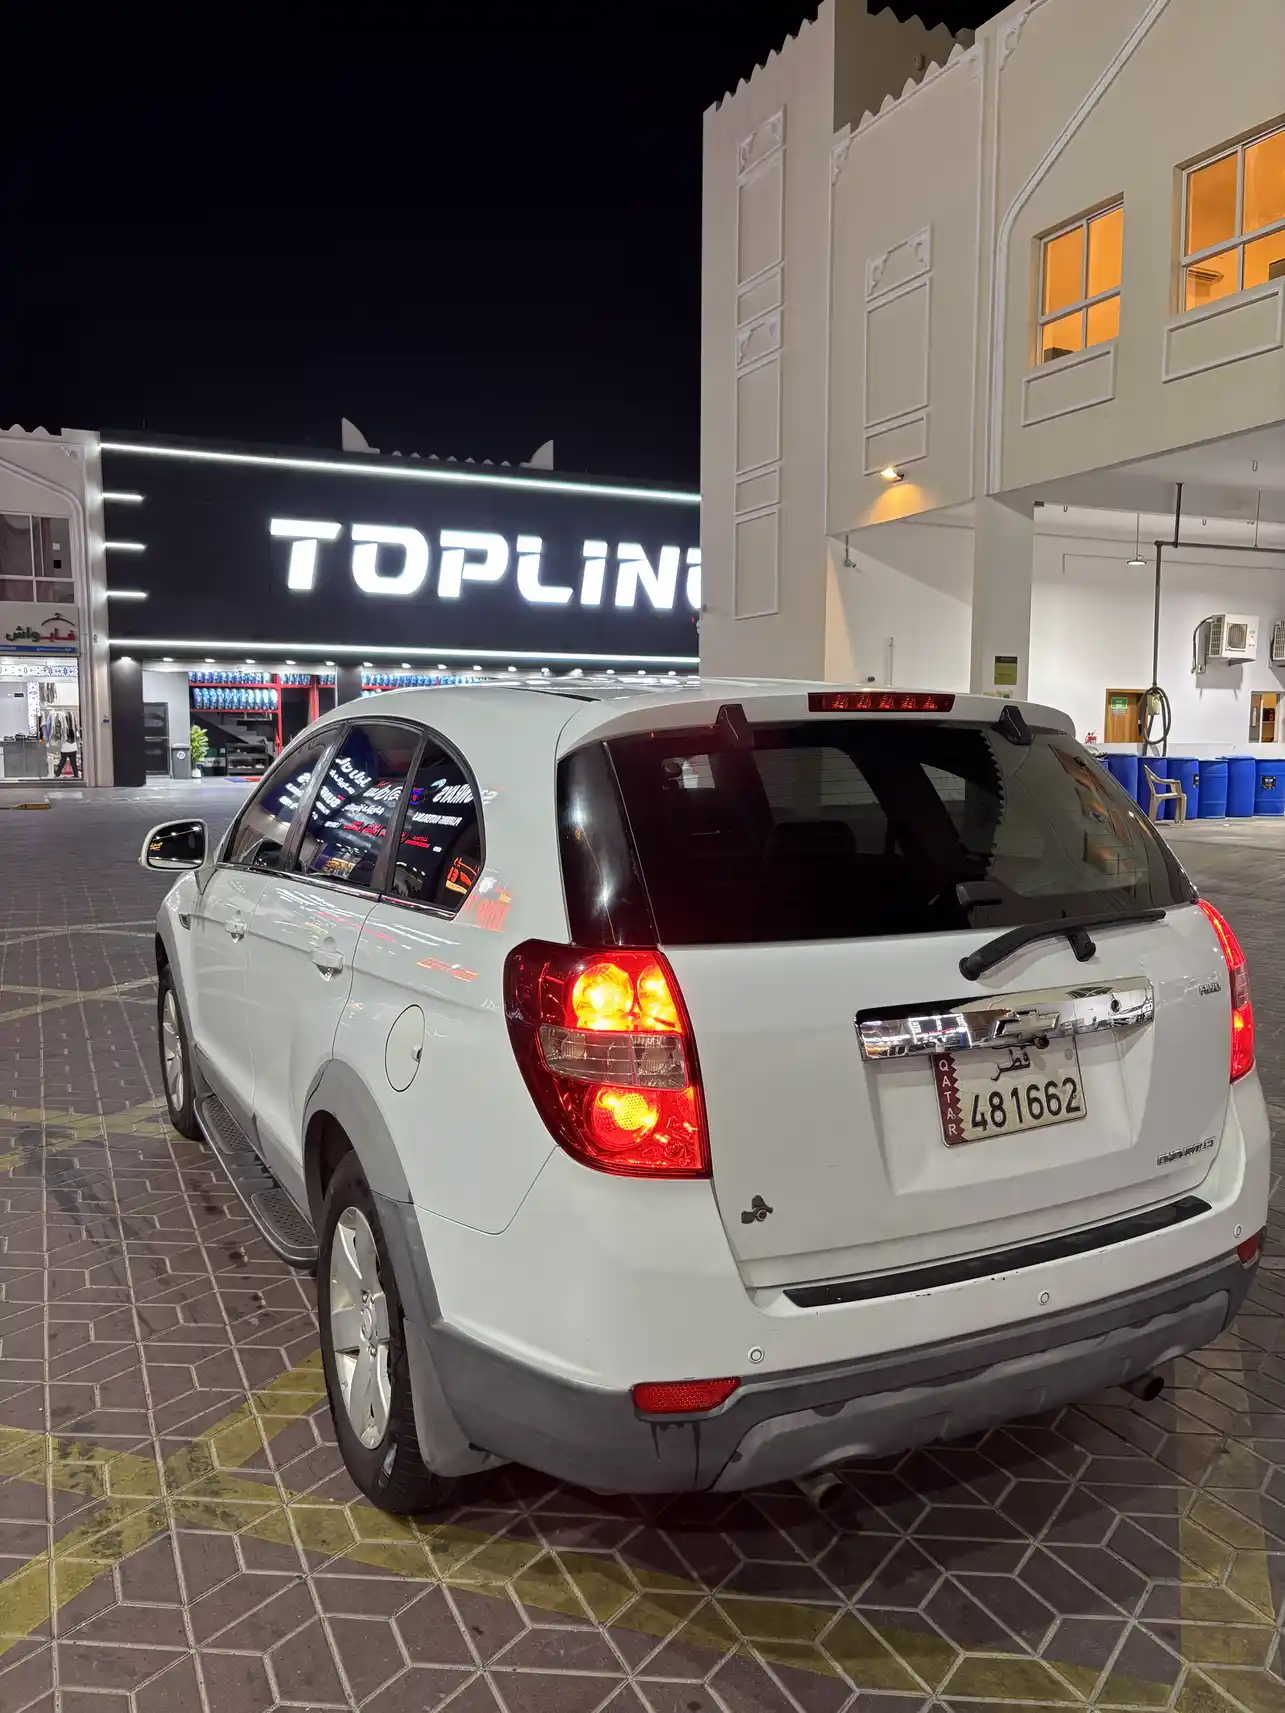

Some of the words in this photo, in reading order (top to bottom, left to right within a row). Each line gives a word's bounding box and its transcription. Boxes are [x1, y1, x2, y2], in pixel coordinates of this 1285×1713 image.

[990, 1046, 1030, 1081] قطر
[938, 1059, 958, 1136] QATAR
[971, 1077, 1081, 1131] 481662
